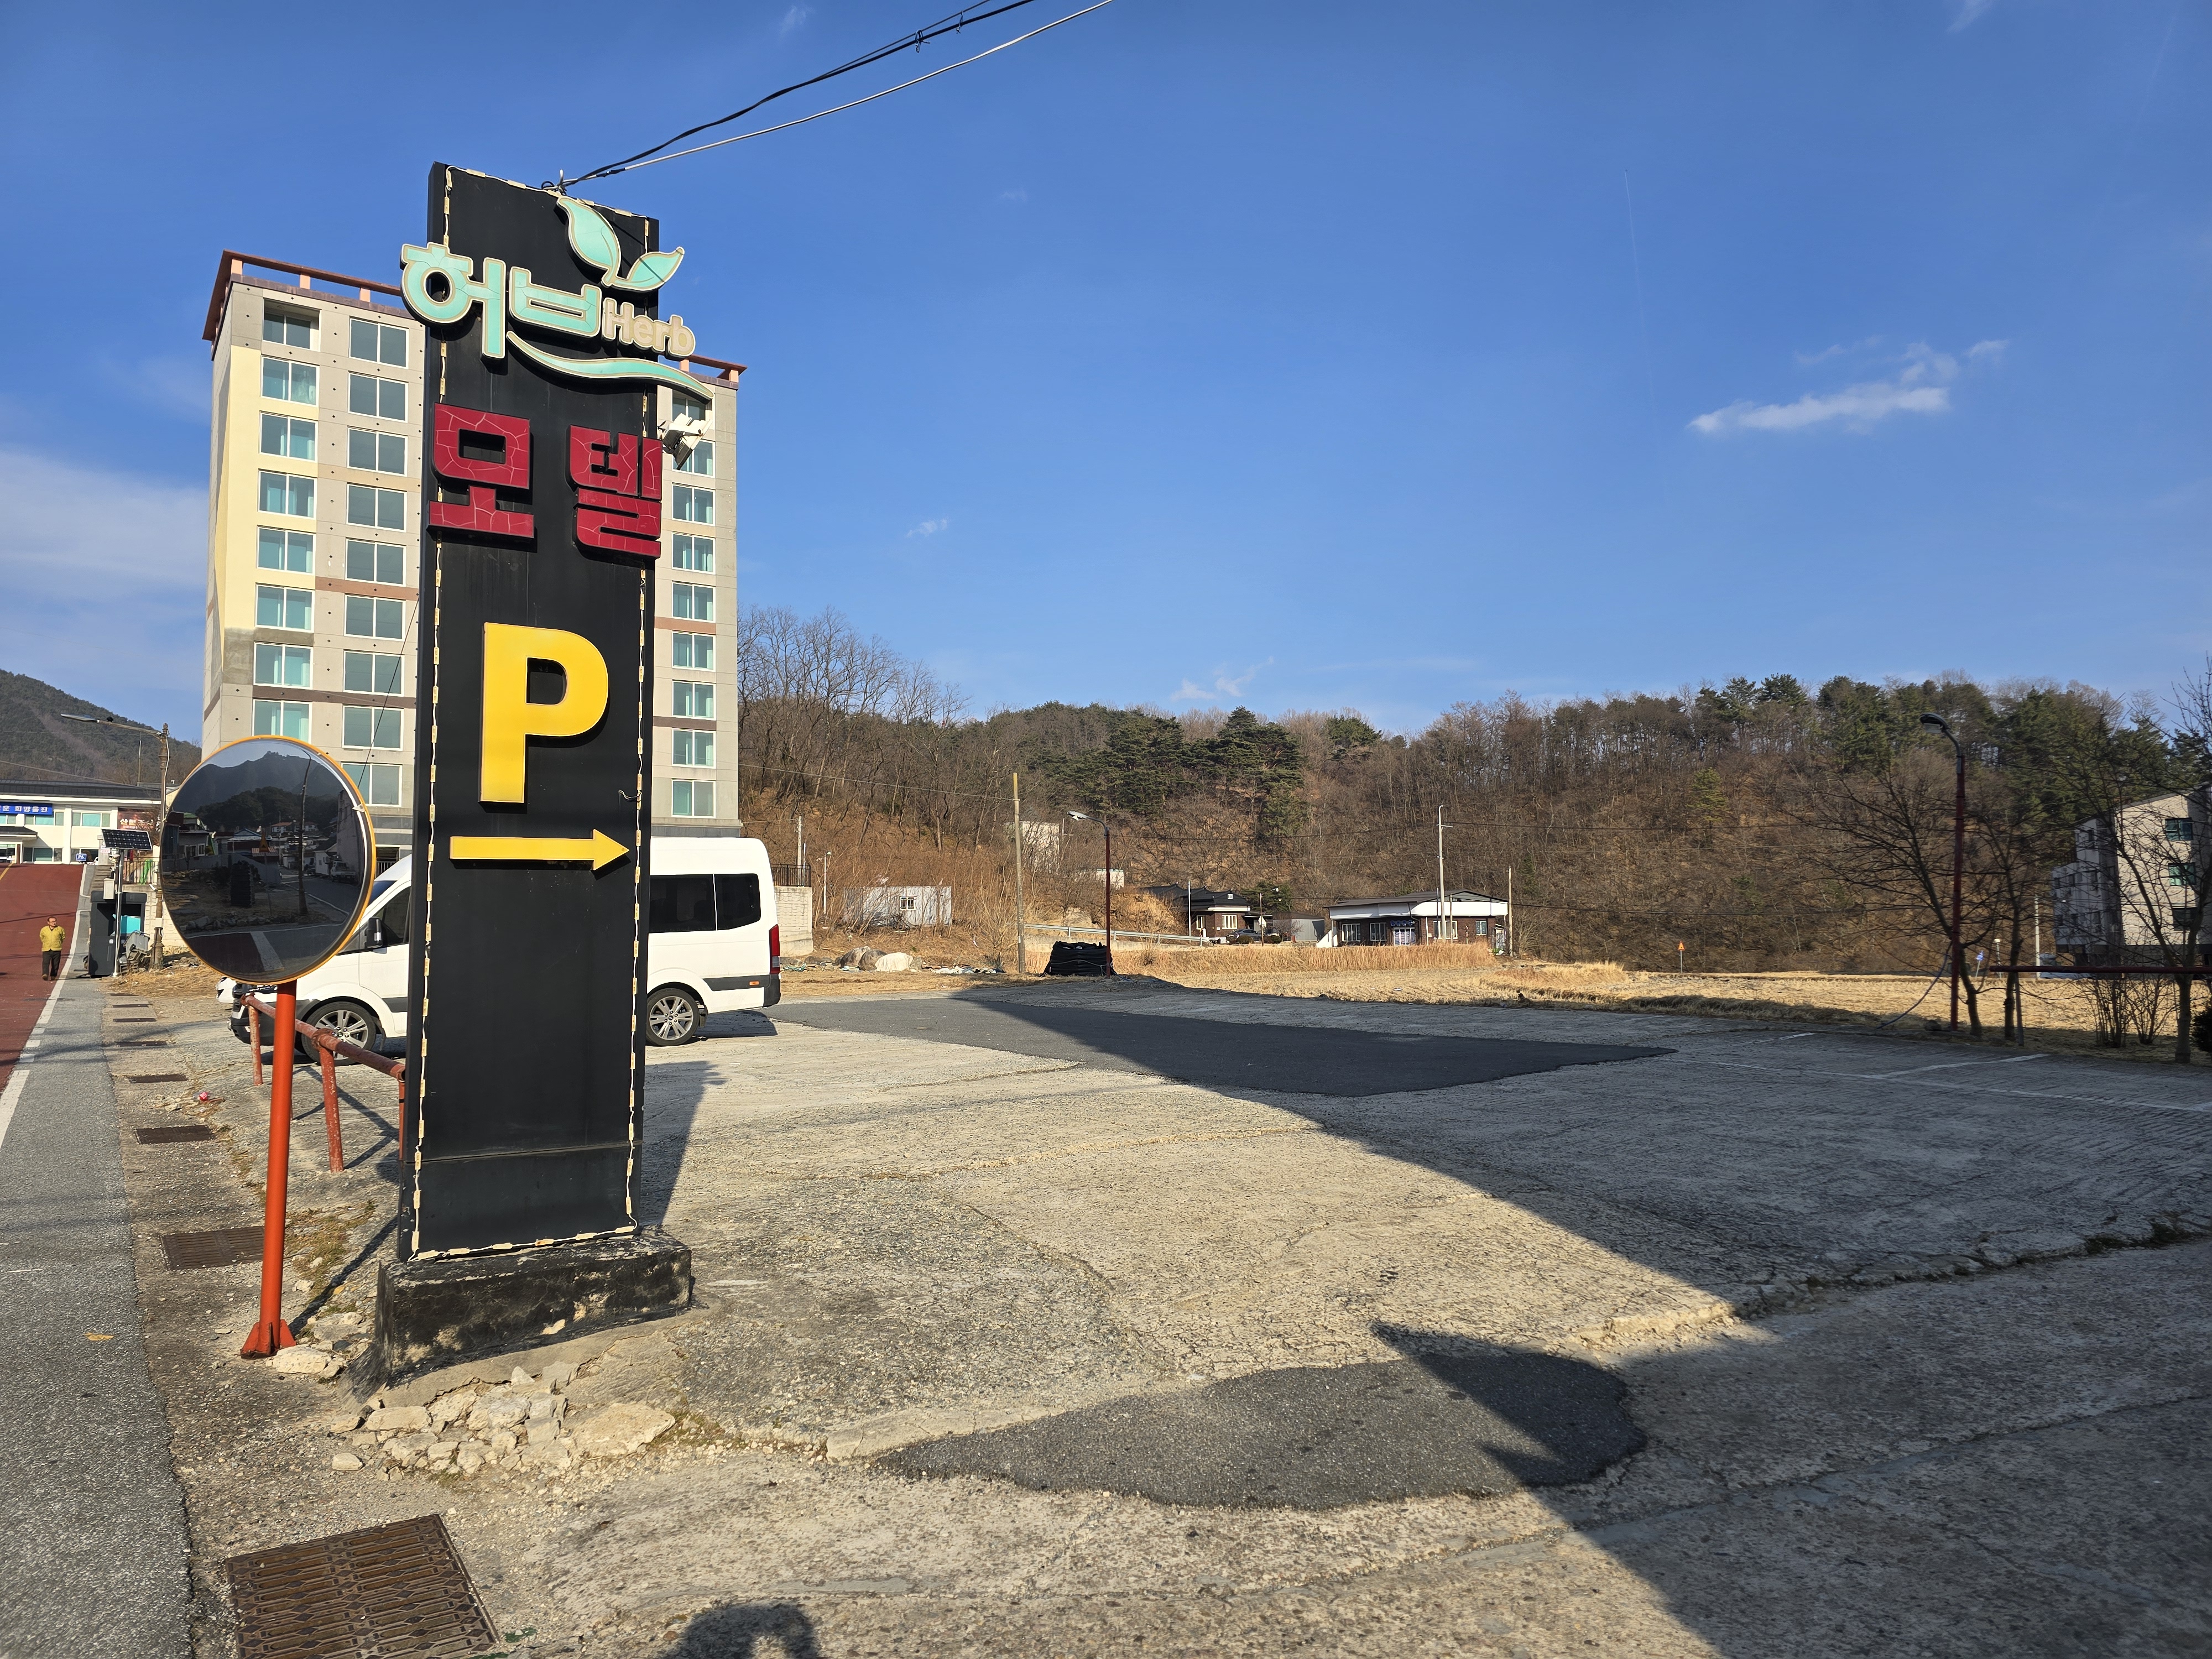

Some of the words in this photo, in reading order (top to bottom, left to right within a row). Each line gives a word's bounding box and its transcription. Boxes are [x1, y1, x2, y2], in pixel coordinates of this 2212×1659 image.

[602, 297, 695, 357] Herb
[429, 403, 662, 559] 모텔
[480, 622, 609, 803] P
